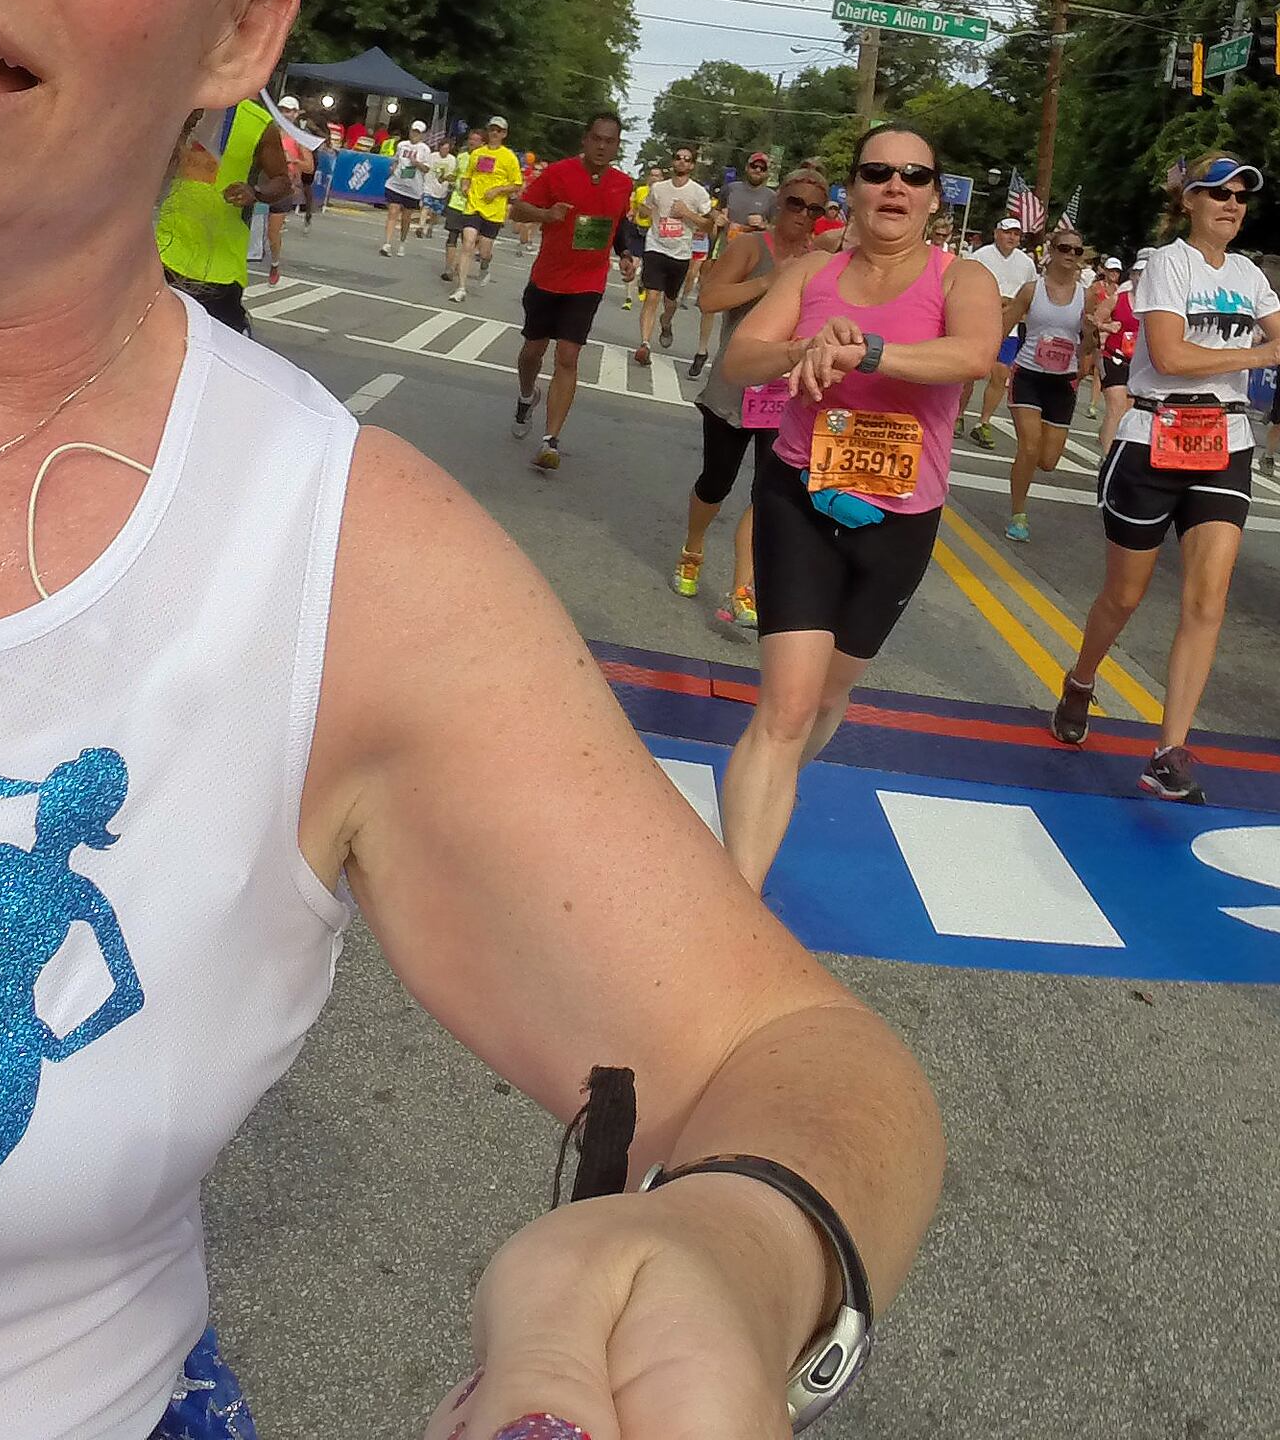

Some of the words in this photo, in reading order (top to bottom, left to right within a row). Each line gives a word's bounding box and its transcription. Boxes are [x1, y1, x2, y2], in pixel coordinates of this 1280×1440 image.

[836, 1, 888, 24] Charles
[892, 10, 927, 31] Allen
[932, 15, 950, 33] Dr
[747, 398, 756, 414] F
[760, 399, 785, 415] 235
[853, 417, 919, 433] Peachtree
[853, 427, 886, 439] Road
[886, 429, 919, 442] Race
[817, 446, 832, 472] J
[840, 449, 913, 479] 35913
